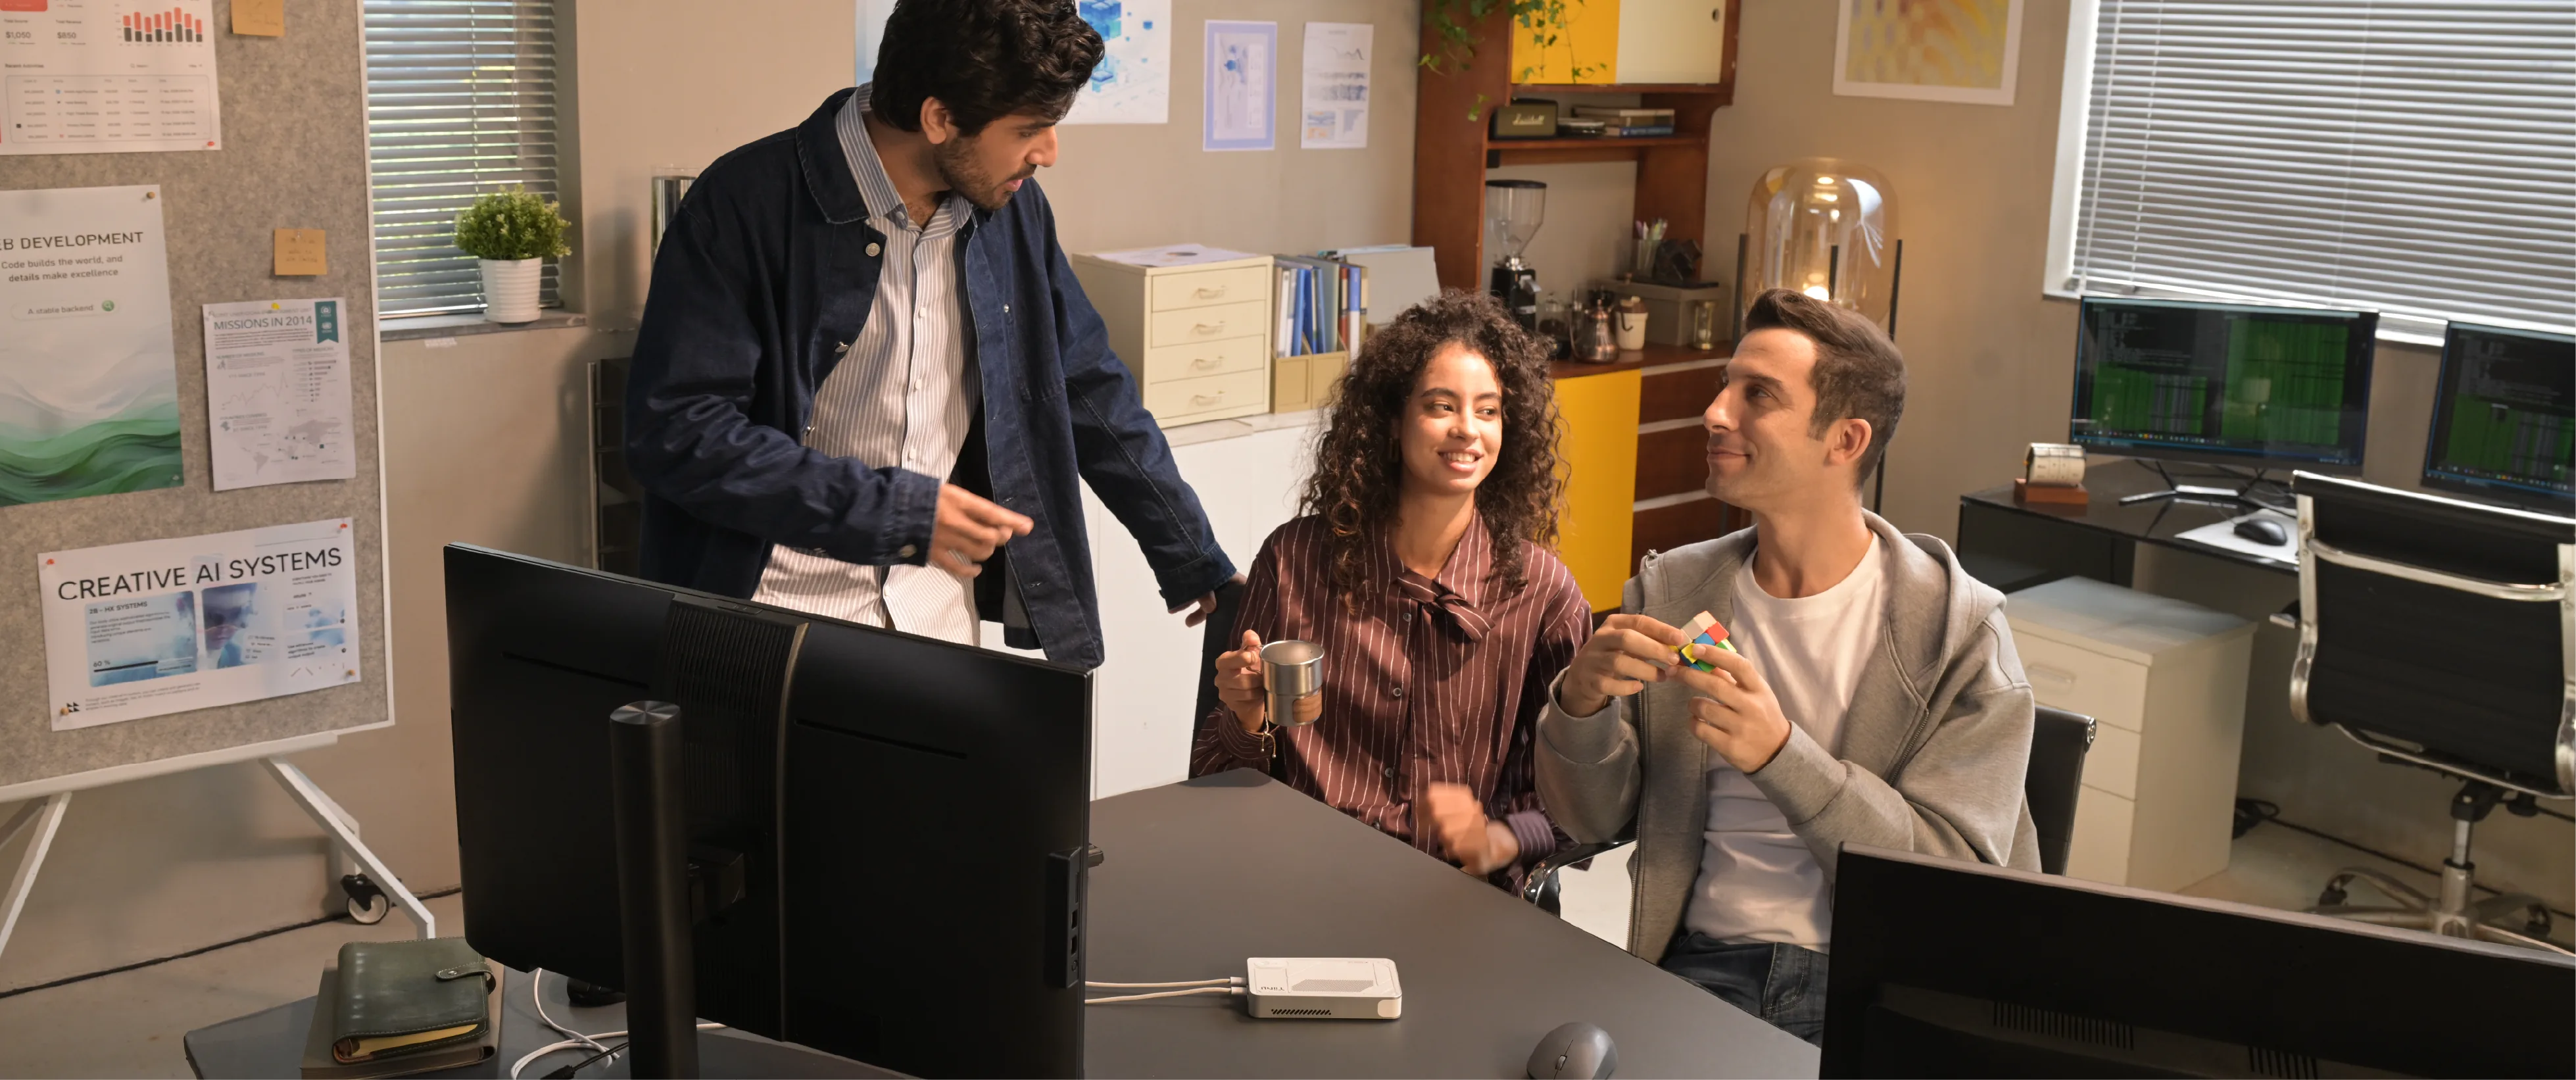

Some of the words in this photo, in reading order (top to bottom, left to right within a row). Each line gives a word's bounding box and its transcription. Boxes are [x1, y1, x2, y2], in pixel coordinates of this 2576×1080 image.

[20, 232, 143, 250] DEVELOPMENT
[1, 260, 25, 269] Code
[28, 259, 55, 268] builds
[75, 257, 104, 265] world,
[9, 273, 39, 282] details
[42, 271, 67, 280] make
[70, 268, 118, 278] excellence
[61, 305, 93, 313] backend
[214, 318, 269, 330] MISSIONS
[271, 317, 283, 327] IN
[286, 316, 312, 326] 2014
[58, 567, 186, 600] CREATIVE
[196, 562, 220, 584] AI
[230, 547, 342, 579] SYSTEMS
[116, 601, 148, 611] SYSTEMS
